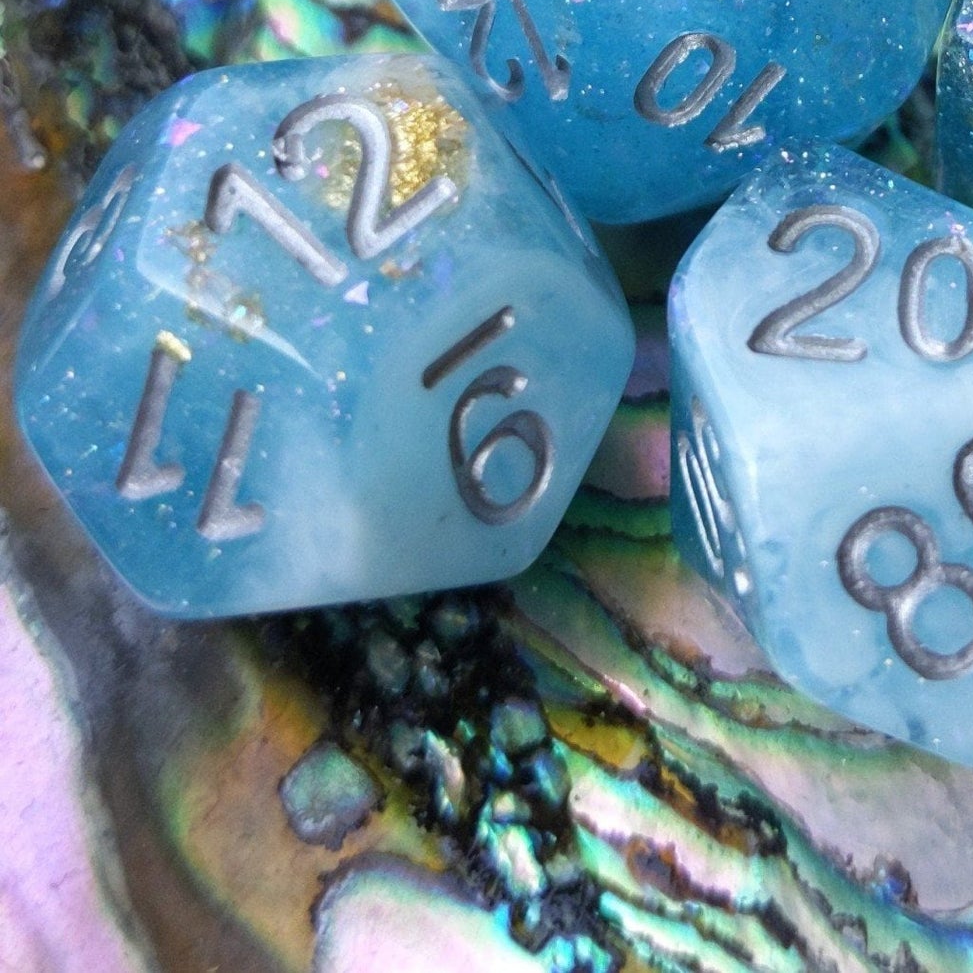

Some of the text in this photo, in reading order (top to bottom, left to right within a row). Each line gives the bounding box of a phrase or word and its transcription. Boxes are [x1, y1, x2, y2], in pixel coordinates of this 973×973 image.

[633, 32, 787, 152] 10
[203, 93, 460, 287] 12
[117, 330, 266, 541] 11
